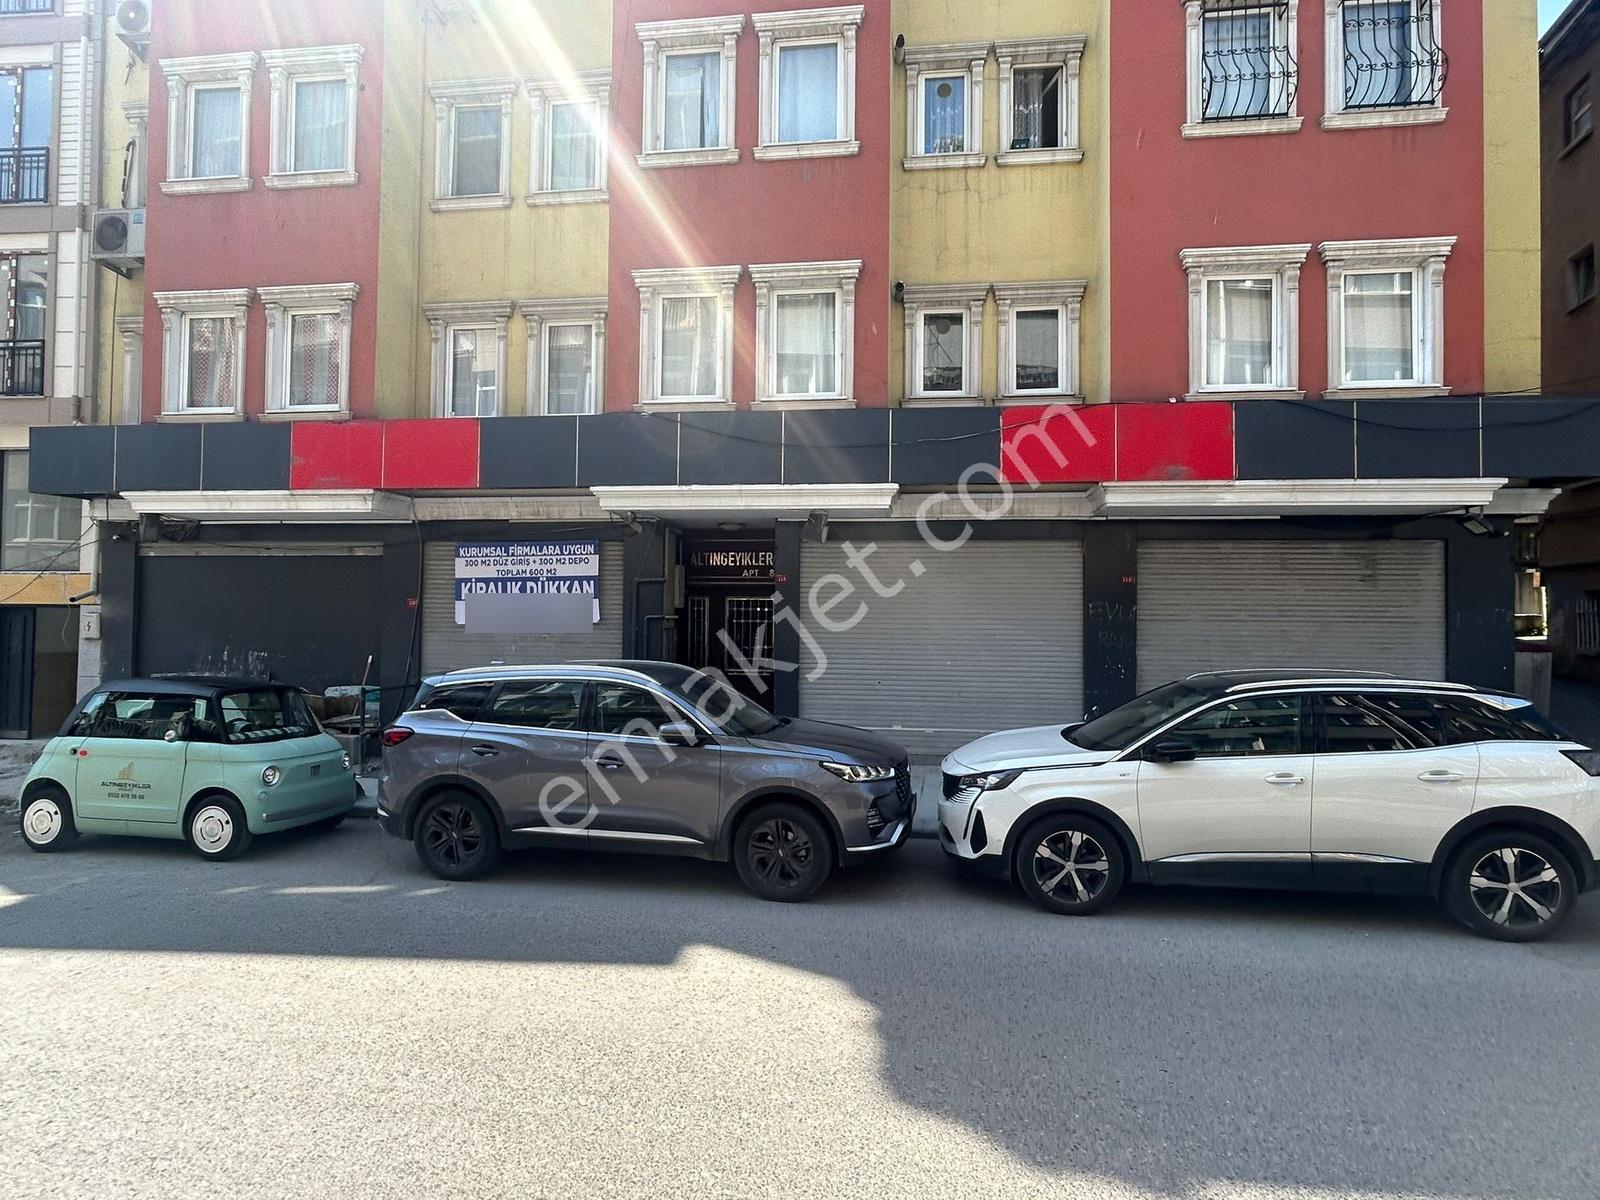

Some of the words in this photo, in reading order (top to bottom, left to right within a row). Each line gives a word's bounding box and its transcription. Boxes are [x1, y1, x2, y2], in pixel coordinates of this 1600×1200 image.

[459, 546, 508, 557] KURUMSAL
[509, 543, 561, 556] FİRMALARA
[562, 544, 595, 555] UYGUN
[464, 559, 479, 567] 300
[480, 559, 492, 567] M2
[493, 557, 509, 566] DÜZ
[510, 557, 531, 567] GİRİŞ
[539, 557, 554, 565] 300
[555, 557, 567, 565] M2
[568, 556, 590, 565] DEPO
[496, 569, 527, 577] TOPLAM
[529, 568, 545, 576] 600
[546, 568, 557, 576] M2
[742, 569, 759, 577] APT
[461, 578, 522, 600] KİRALIK
[526, 576, 595, 597] DÜKKAN
